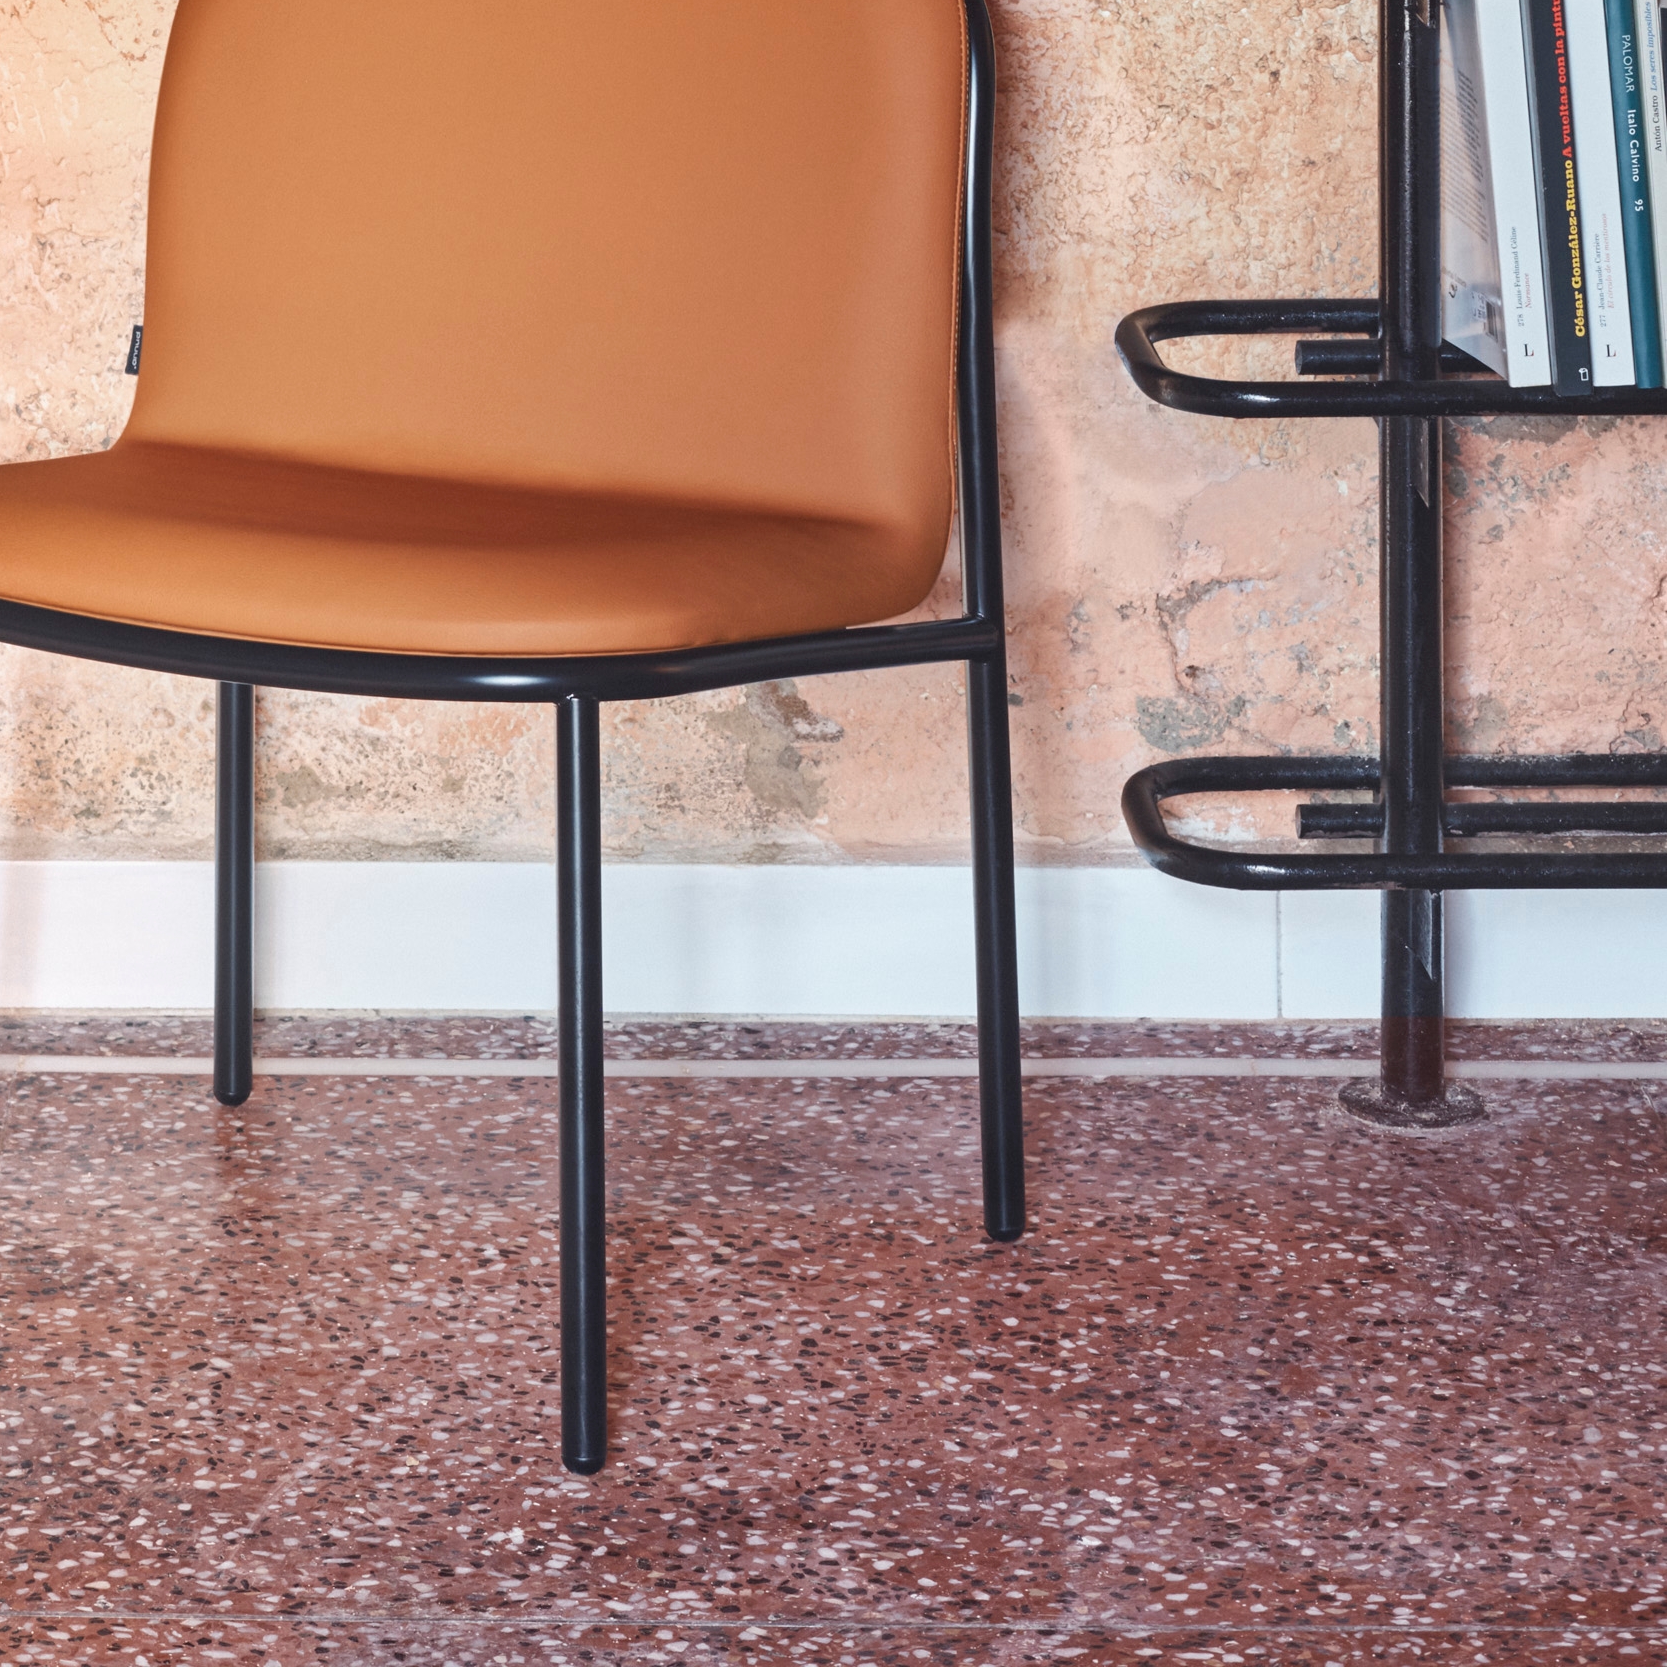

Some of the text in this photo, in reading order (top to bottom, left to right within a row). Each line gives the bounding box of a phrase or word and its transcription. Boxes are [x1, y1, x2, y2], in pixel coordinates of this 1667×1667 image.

[1555, 39, 1564, 55] la
[1621, 34, 1635, 94] PALOMAR
[1556, 56, 1566, 83] con
[1559, 85, 1572, 144] vueltas
[1562, 145, 1572, 158] A
[1627, 107, 1641, 182] Italo Calvino
[1635, 199, 1643, 211] 95
[1564, 159, 1585, 337] César González-Ruano
